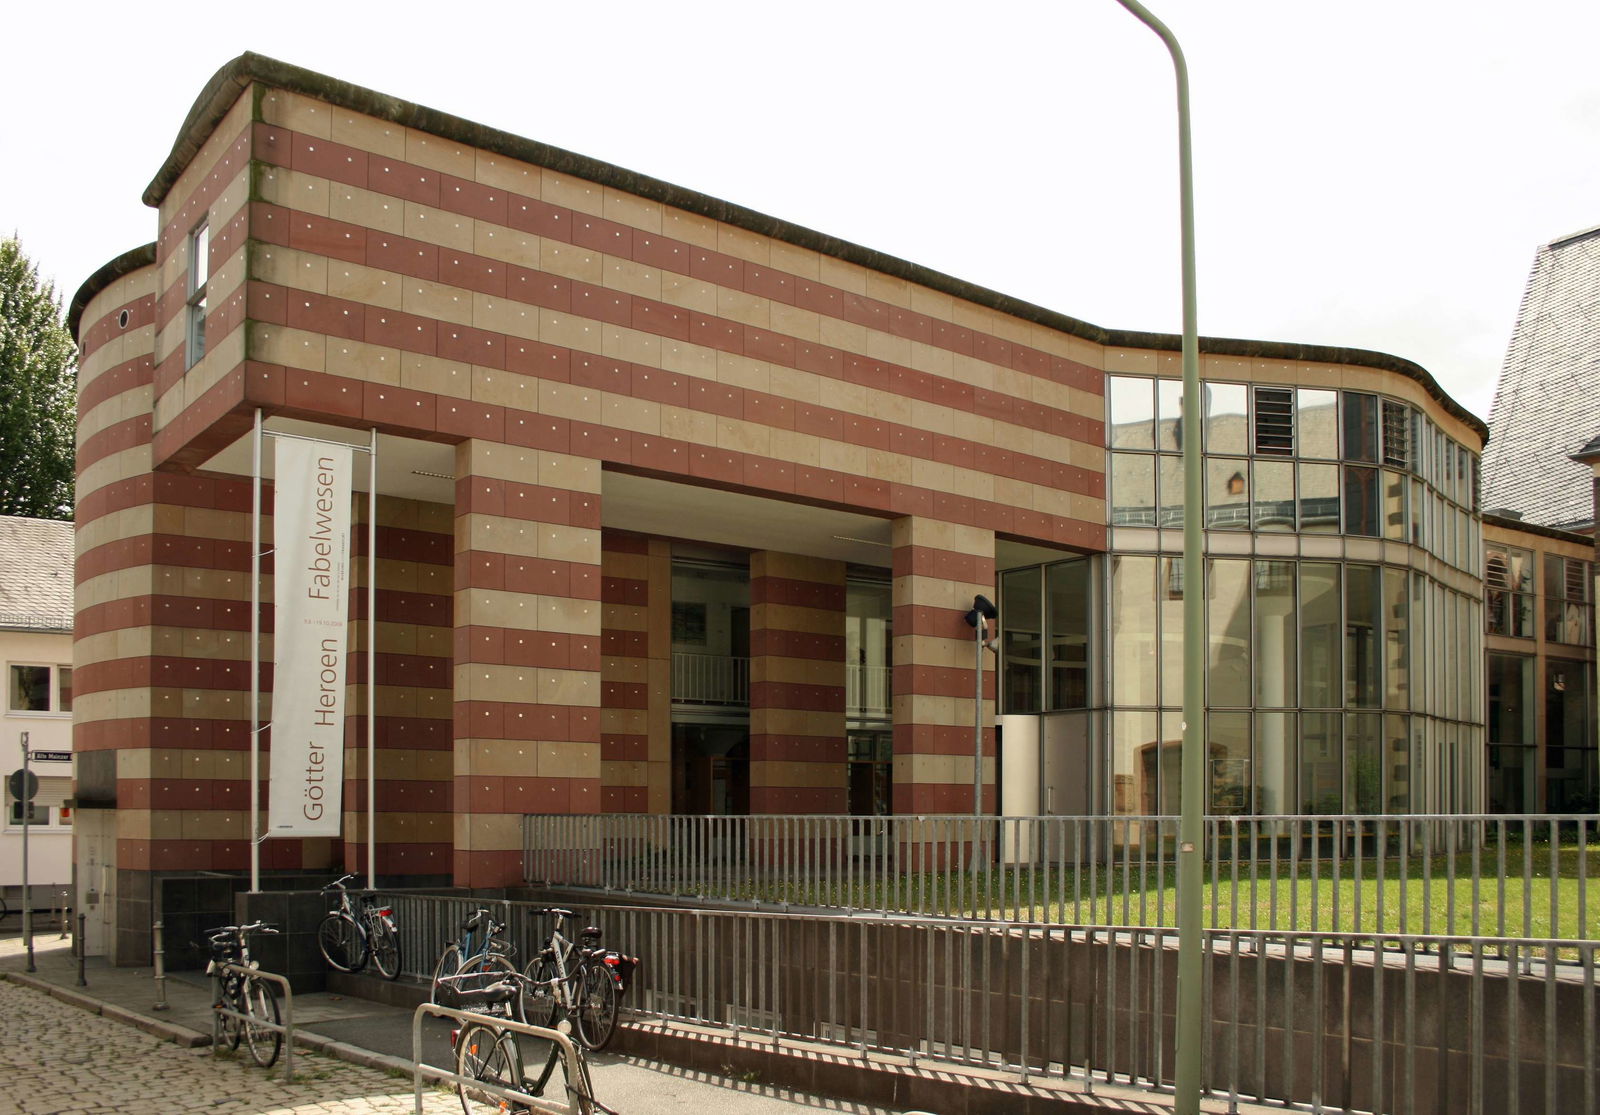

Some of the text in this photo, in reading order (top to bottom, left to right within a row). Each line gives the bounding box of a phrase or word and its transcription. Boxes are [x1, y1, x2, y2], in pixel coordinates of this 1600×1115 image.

[303, 457, 338, 820] Götter Heroen Fabelwesen
